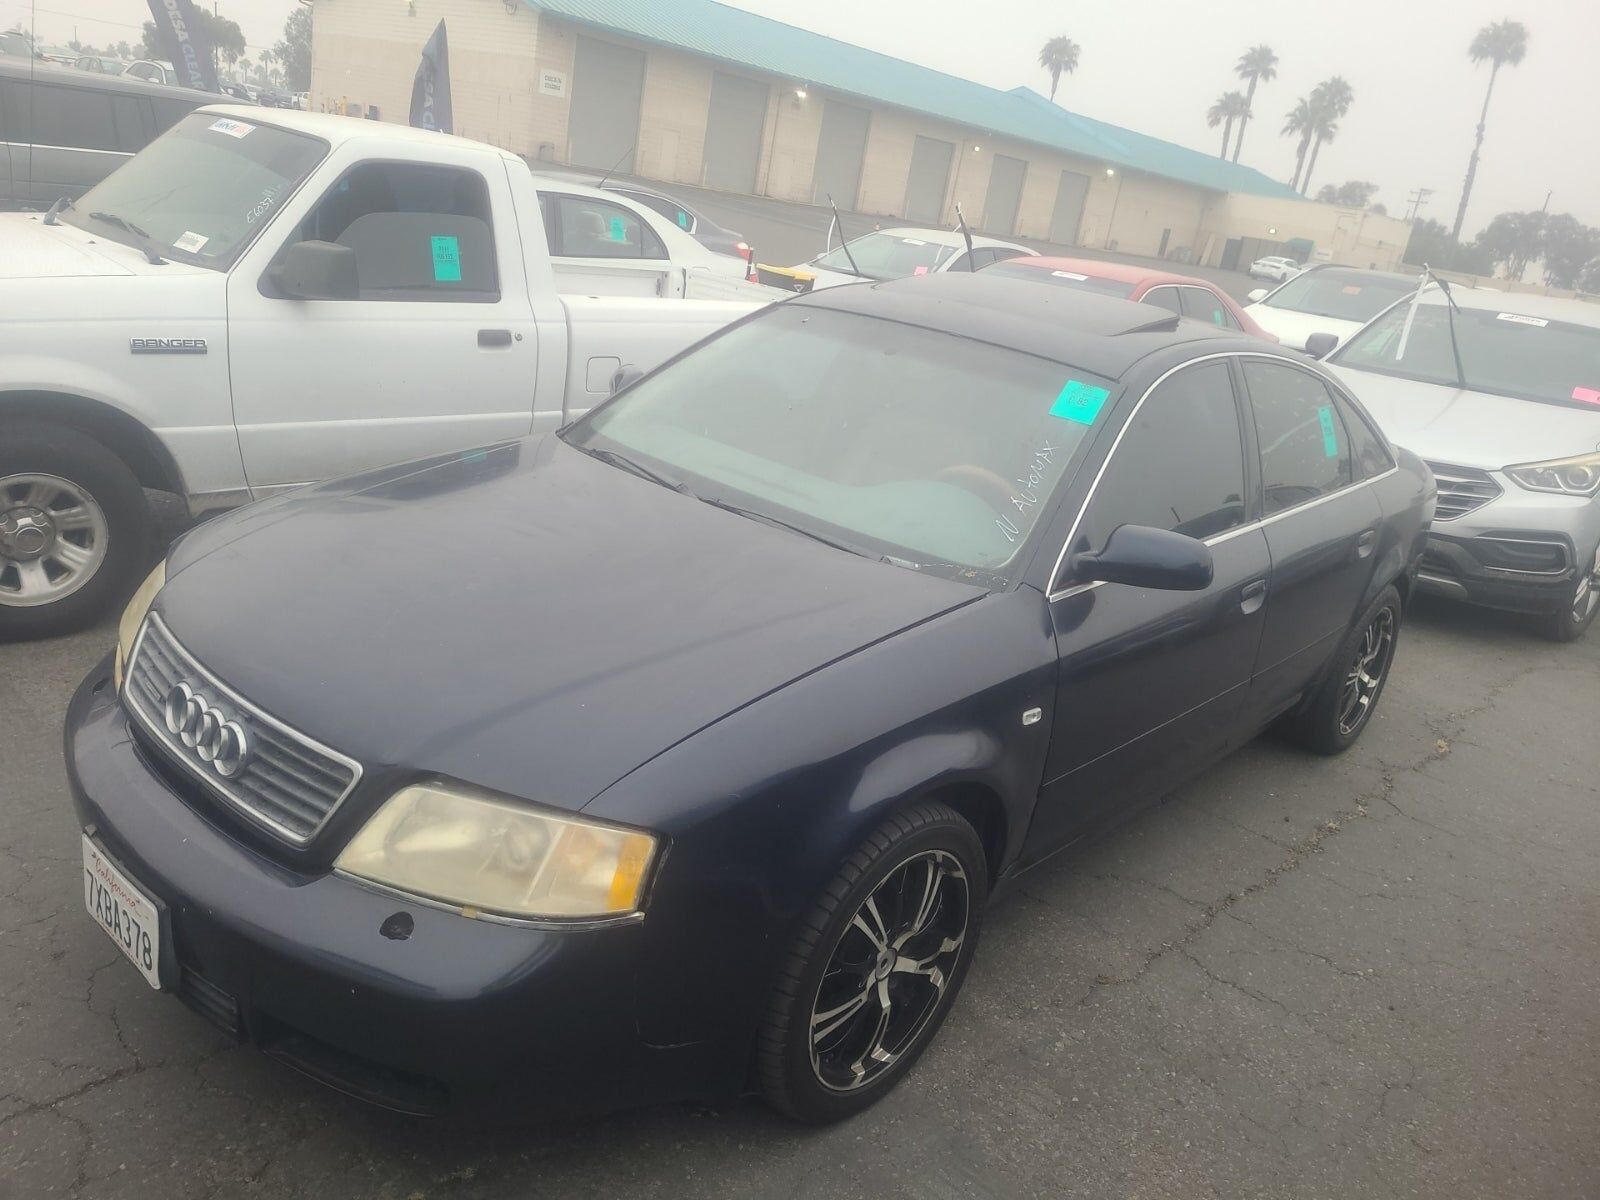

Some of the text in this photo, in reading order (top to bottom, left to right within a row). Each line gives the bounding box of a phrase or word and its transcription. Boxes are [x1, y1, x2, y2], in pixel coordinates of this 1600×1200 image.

[131, 338, 207, 350] RANGER
[93, 857, 138, 908] California
[86, 868, 153, 972] 7XBA378
